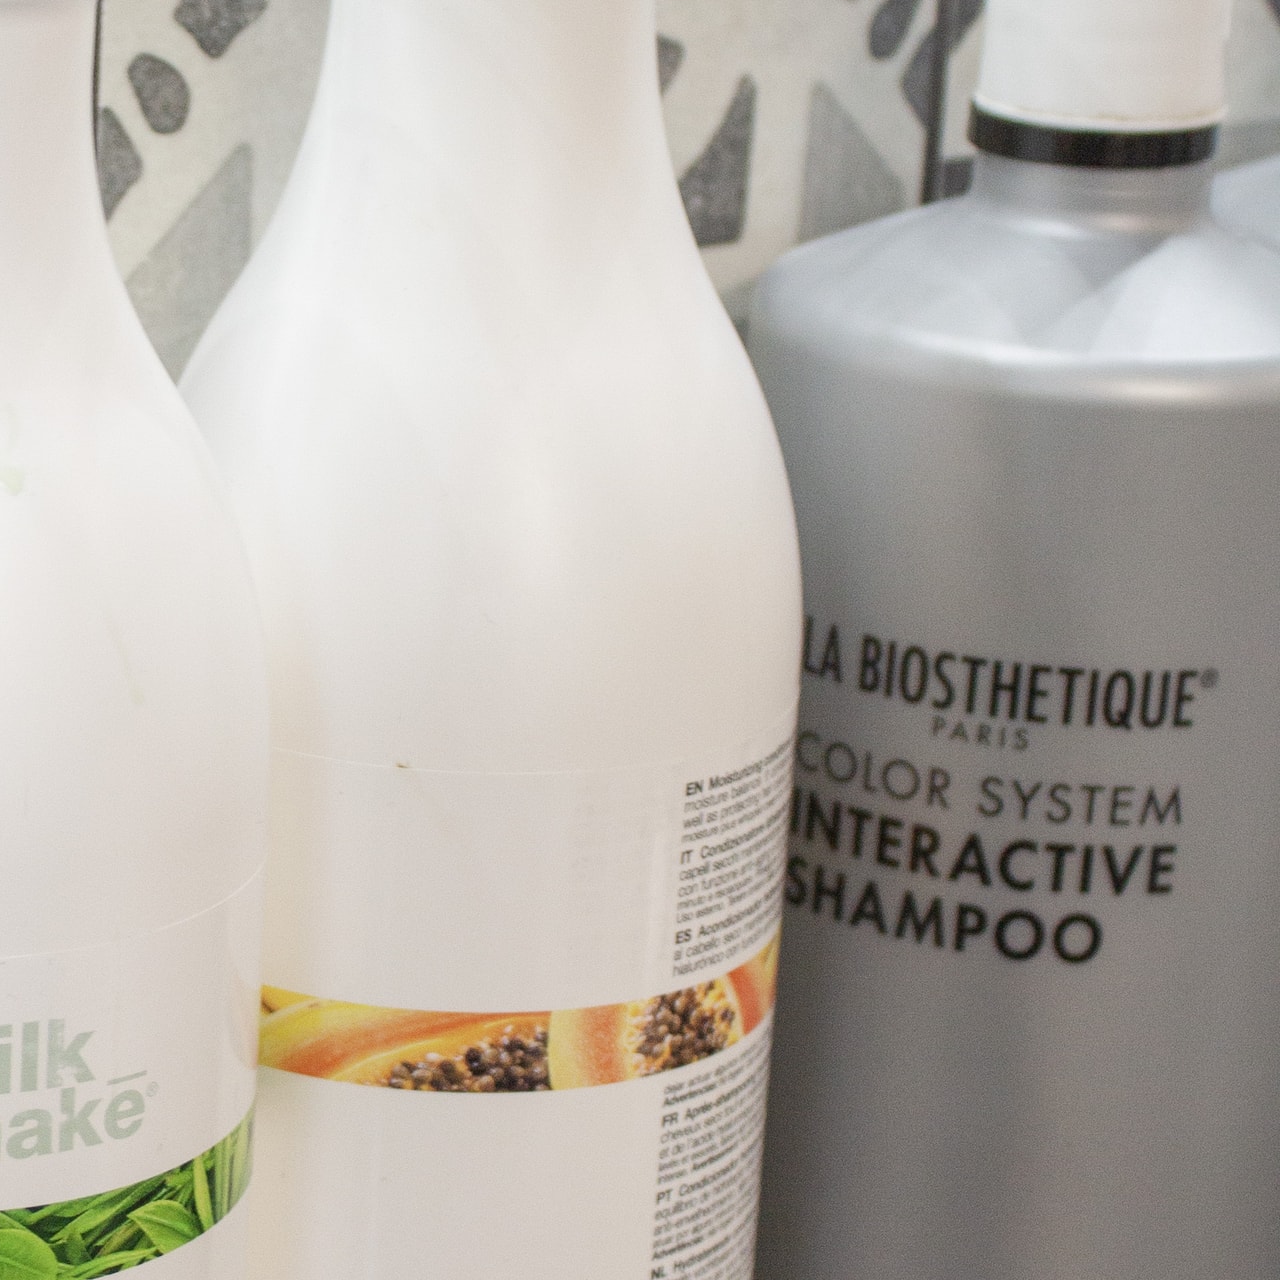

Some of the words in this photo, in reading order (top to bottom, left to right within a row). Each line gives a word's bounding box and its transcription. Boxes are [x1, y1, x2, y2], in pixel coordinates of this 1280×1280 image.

[795, 730, 952, 810] COLOR
[977, 775, 1184, 828] SYSTEM
[931, 717, 1030, 752] PARIS
[789, 786, 1178, 896] INTERACTIVE
[783, 856, 1104, 964] SHAMPOO
